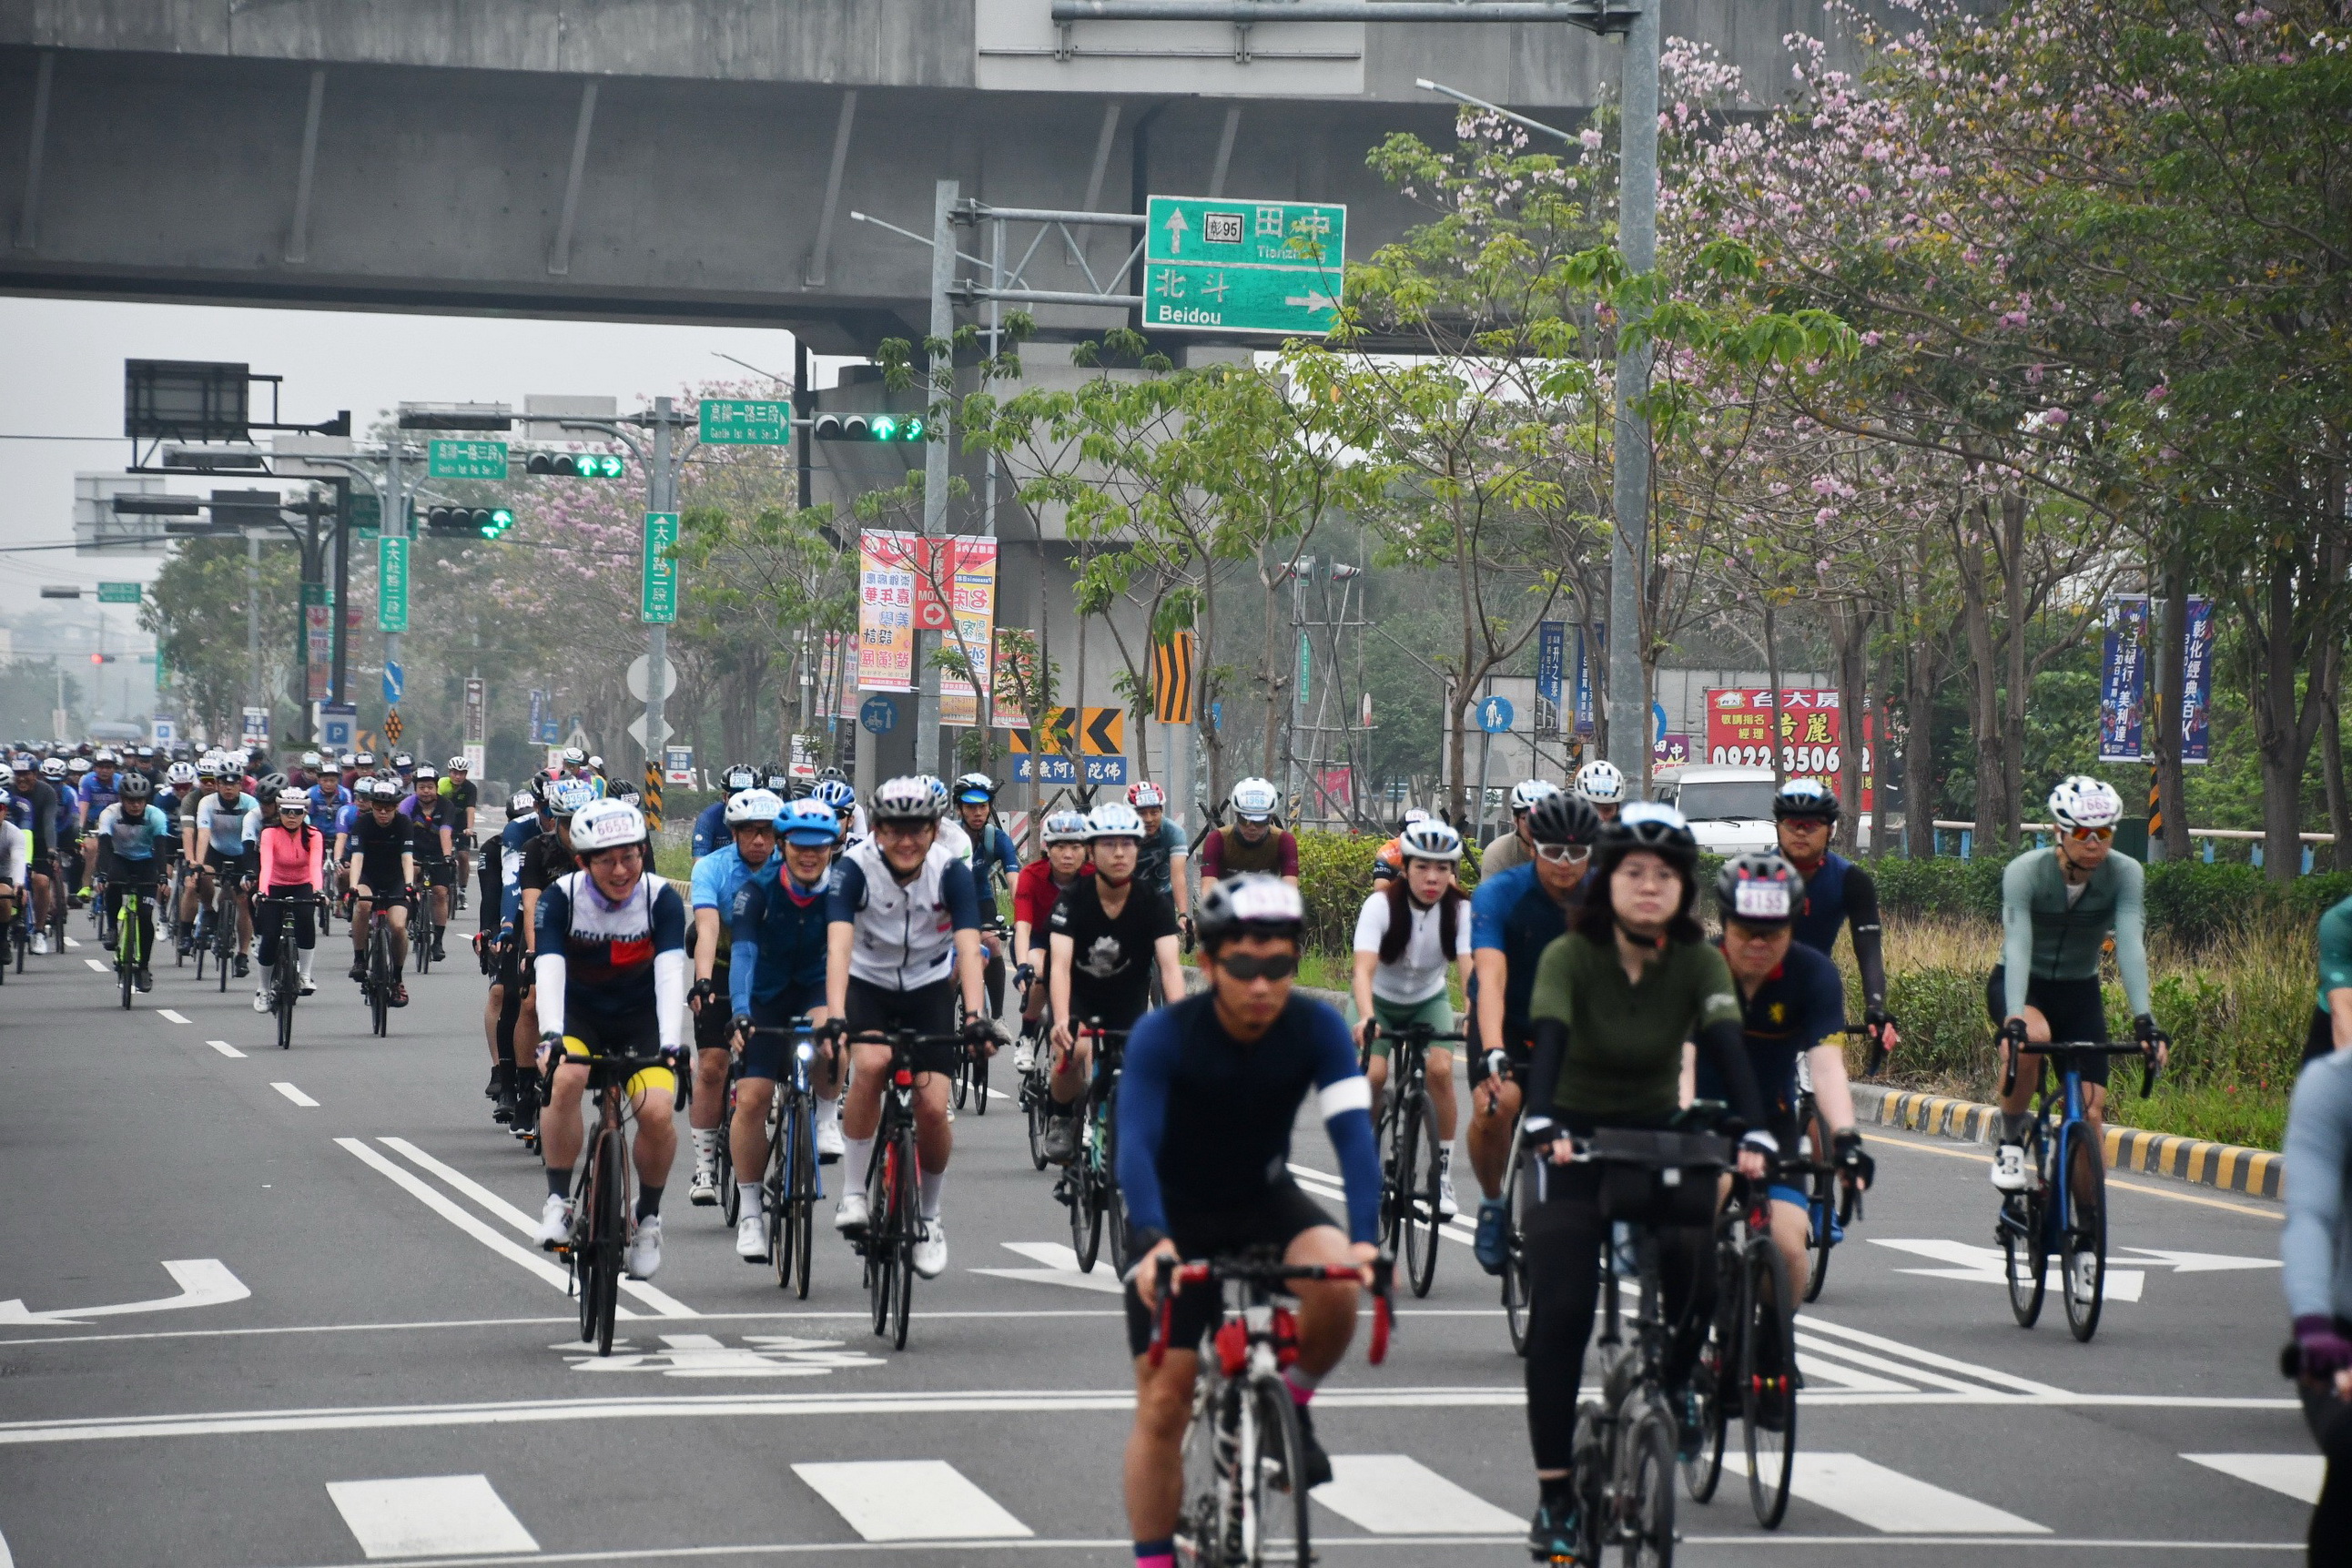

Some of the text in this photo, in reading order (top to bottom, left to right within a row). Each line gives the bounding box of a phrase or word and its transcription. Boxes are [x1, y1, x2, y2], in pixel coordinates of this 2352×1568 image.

[1210, 220, 1238, 237] 彰95
[1255, 207, 1330, 241] 田中
[1256, 245, 1327, 264] Tianzhg
[1154, 268, 1230, 303] 北斗
[1159, 305, 1222, 325] Beidou
[918, 591, 952, 602] MOL
[1721, 713, 1765, 725] 敬請指名
[1769, 712, 1841, 744] 黃麗
[1738, 727, 1764, 740] 經理
[1654, 740, 1684, 760] 田中
[1712, 744, 1870, 773] 092235062
[1019, 759, 1121, 782] 南無阿陀佛
[597, 820, 629, 835] 6655
